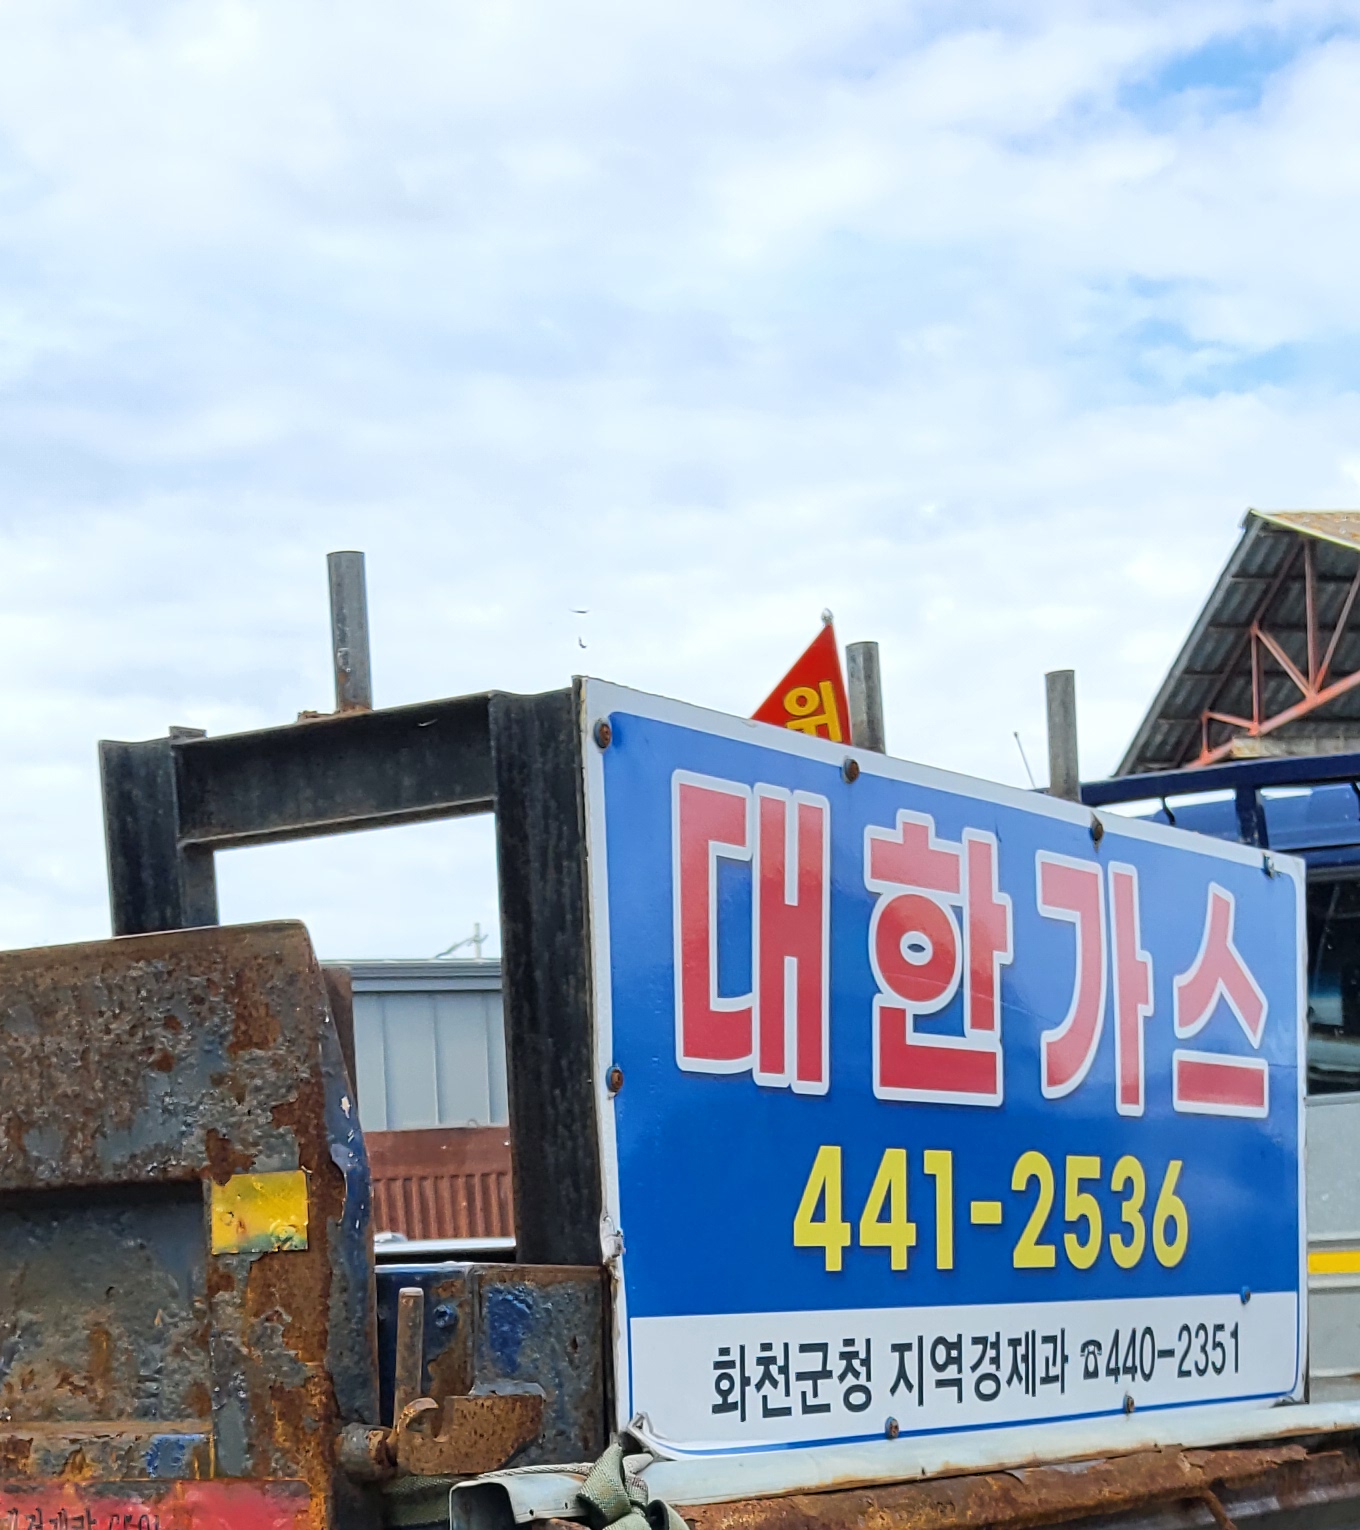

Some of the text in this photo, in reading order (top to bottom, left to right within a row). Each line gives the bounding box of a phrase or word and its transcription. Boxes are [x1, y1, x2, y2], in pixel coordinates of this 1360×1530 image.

[672, 768, 1270, 1118] 대한가스
[793, 1145, 1189, 1272] 441-2536
[711, 1321, 1241, 1423] 화천군청 지역경제과 440-2351
